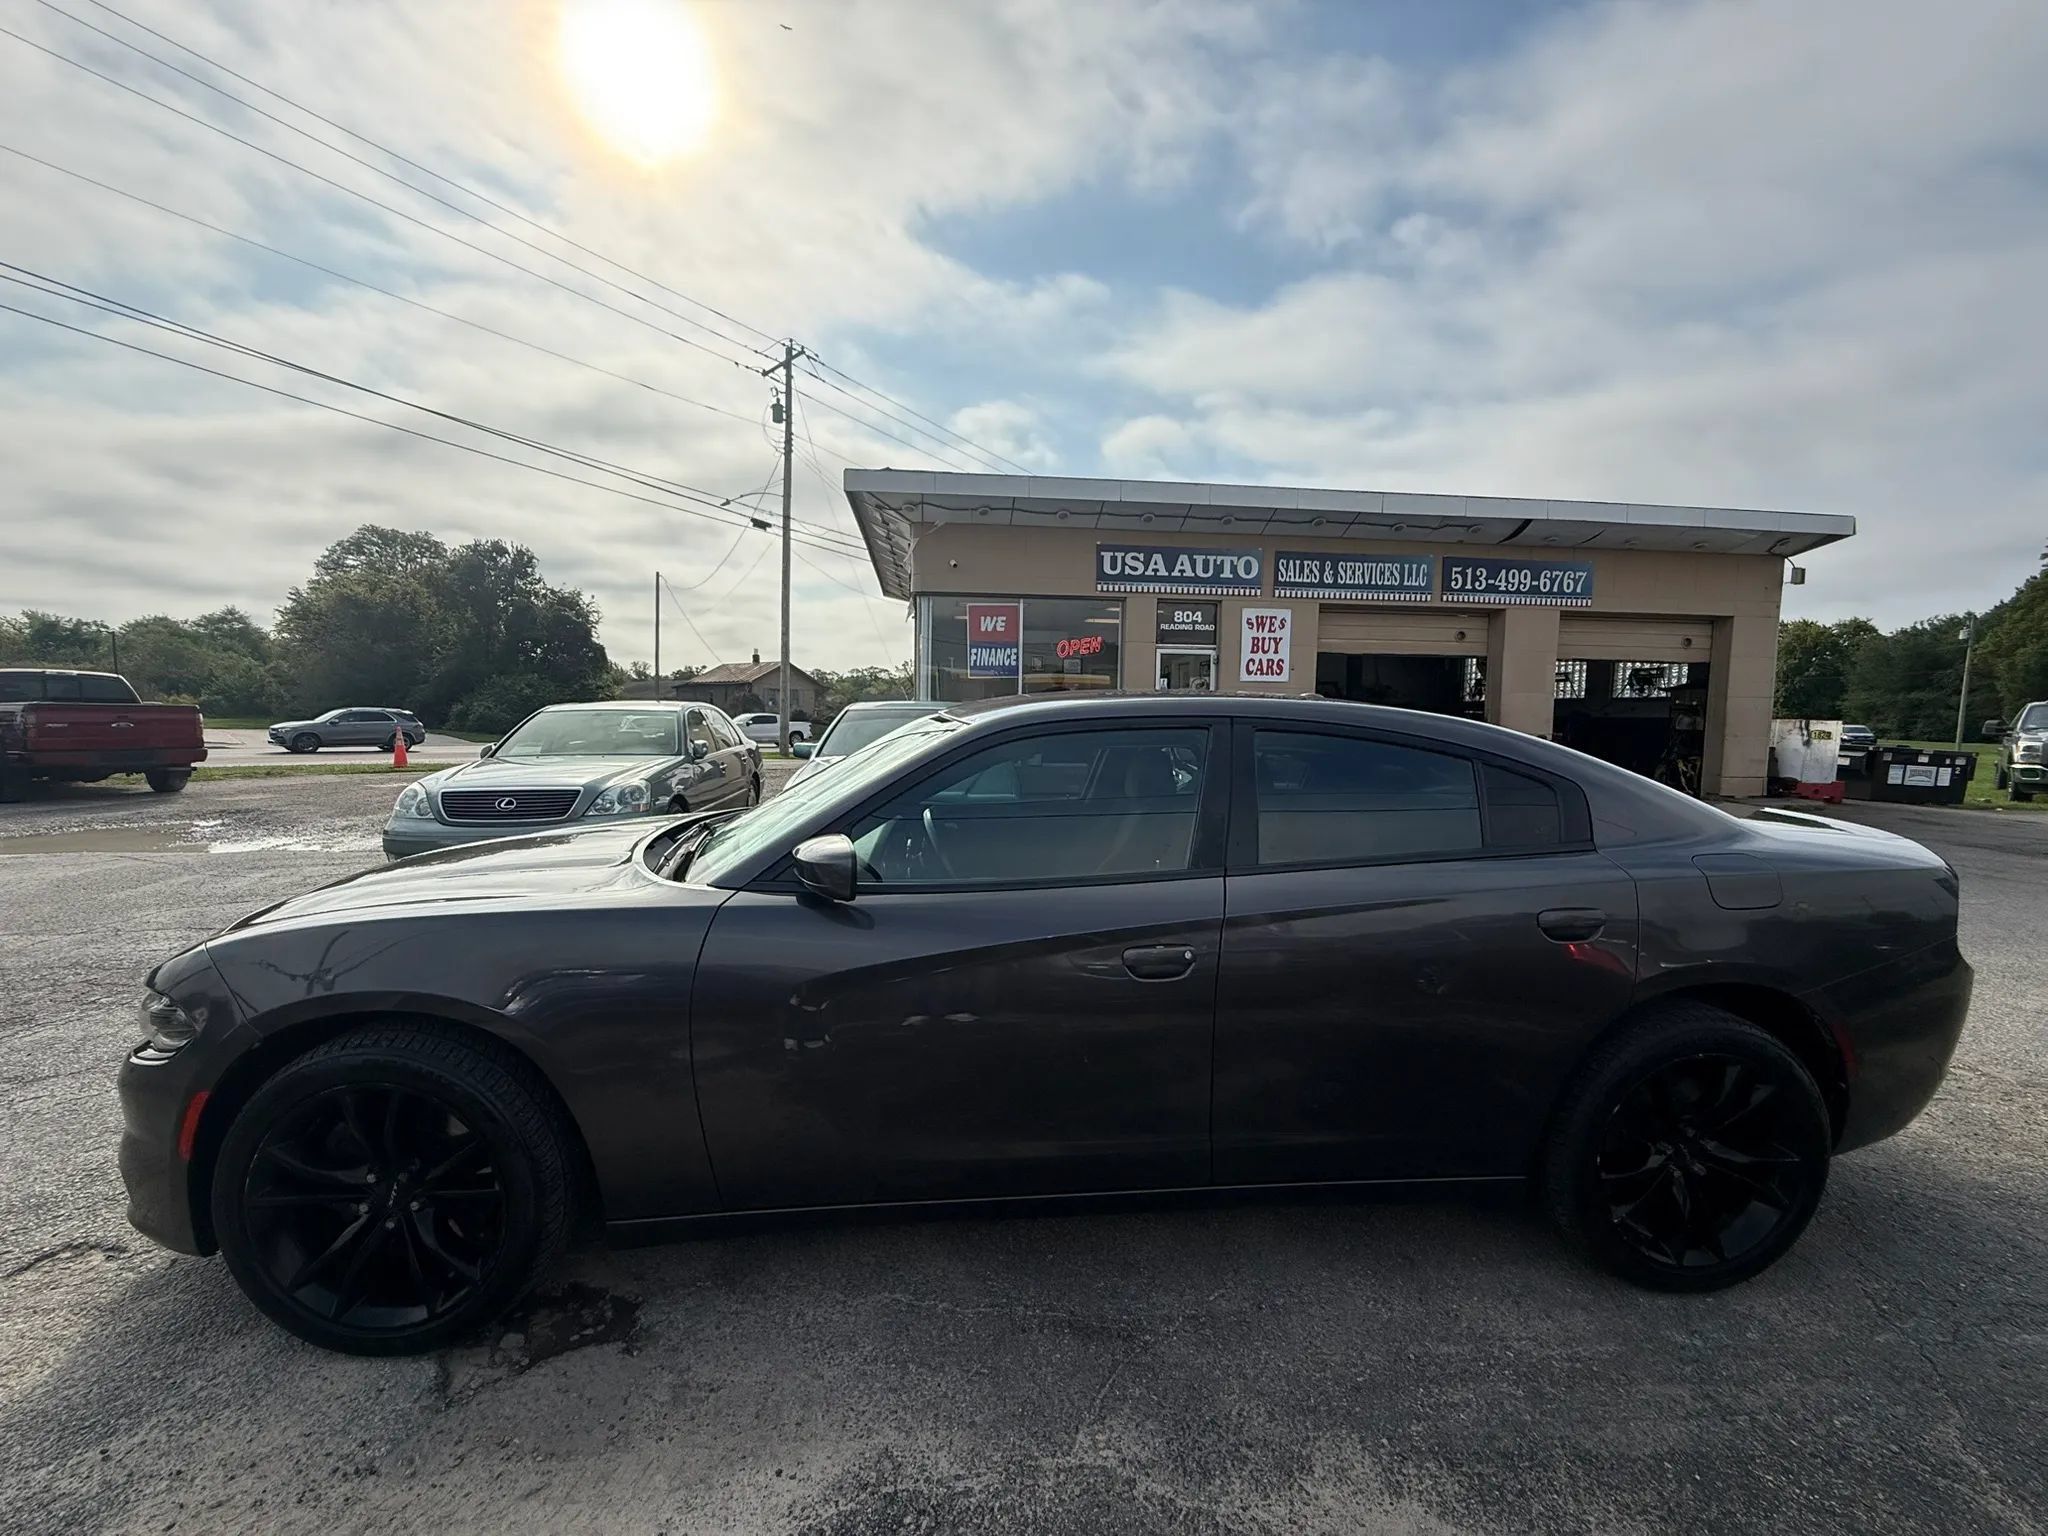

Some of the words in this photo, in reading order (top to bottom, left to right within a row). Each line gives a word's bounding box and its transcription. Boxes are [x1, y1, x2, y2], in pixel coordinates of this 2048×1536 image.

[1100, 551, 1168, 576] USA
[1171, 554, 1259, 579] AUTO
[1278, 558, 1320, 583] SALES
[1323, 561, 1334, 584] &
[1337, 561, 1400, 586] SERVICES
[1403, 563, 1427, 586] LLC
[1450, 566, 1587, 593] 513-499-6767
[980, 616, 1007, 632] WE
[1174, 611, 1202, 623] 804
[1160, 623, 1193, 631] READING
[1056, 636, 1102, 658] OPEN
[1250, 637, 1282, 654] BUY
[970, 648, 1017, 666] FINANCE
[1245, 658, 1284, 676] CARS
